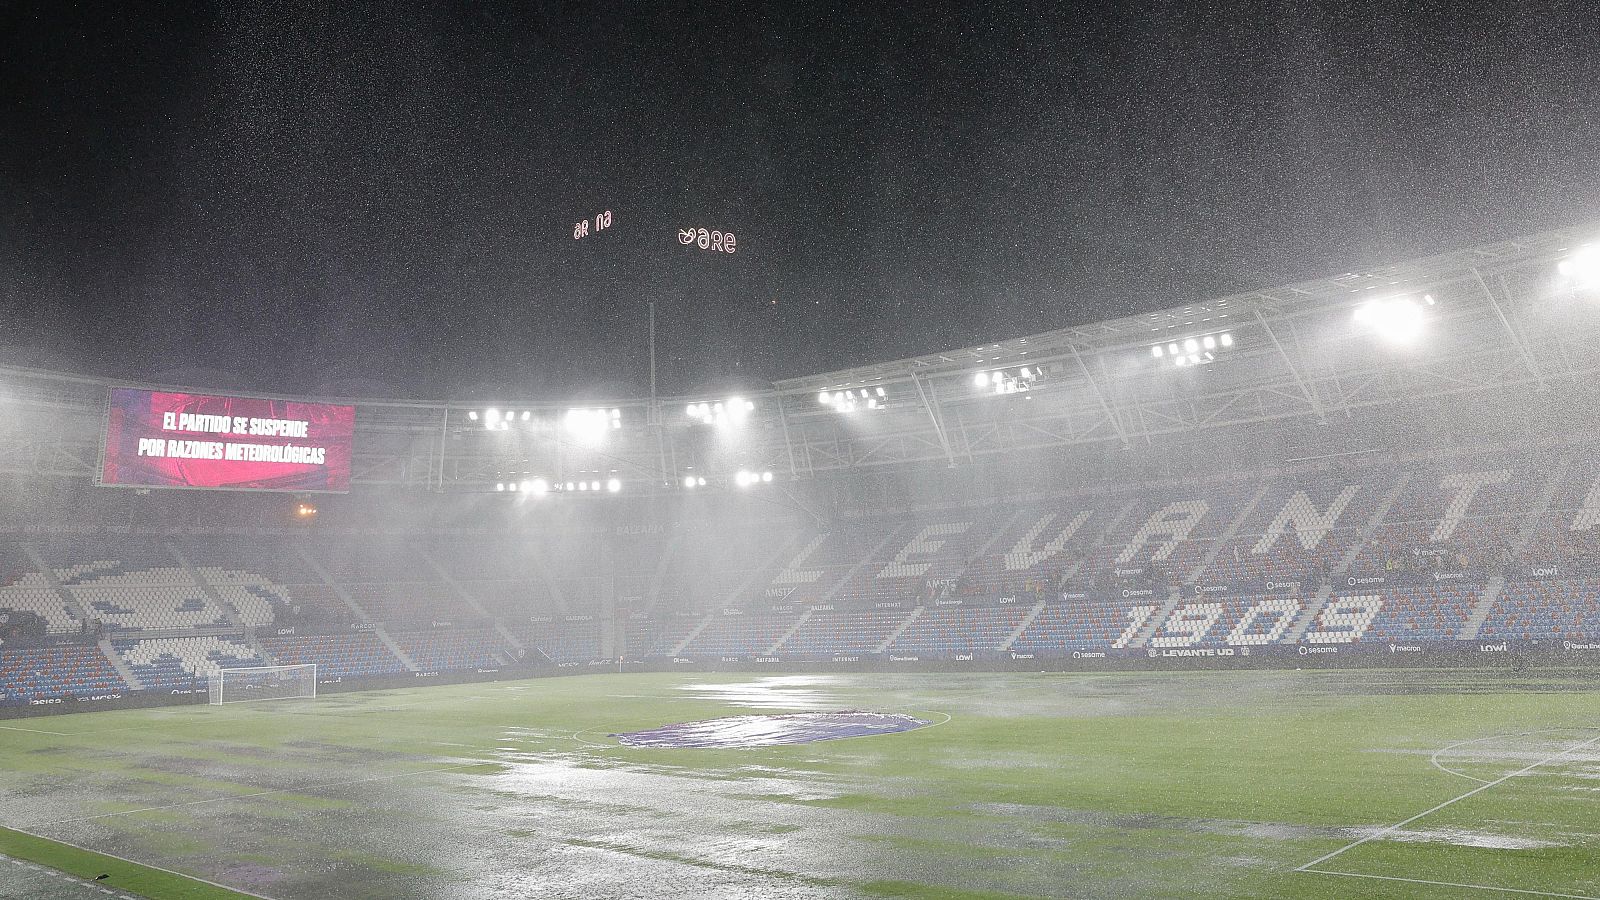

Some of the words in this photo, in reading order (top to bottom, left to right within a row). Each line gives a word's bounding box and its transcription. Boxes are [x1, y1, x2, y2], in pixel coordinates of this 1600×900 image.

[163, 411, 177, 430] EL
[179, 413, 231, 434] PARTIDO
[233, 416, 249, 436] SE
[249, 417, 309, 438] SUSPENDE
[138, 437, 165, 457] POR
[167, 438, 223, 460] RAZONES
[225, 442, 326, 465] METEOROLÓGICAS
[1129, 588, 1152, 596] sesame
[1111, 595, 1383, 649] 1909
[1163, 649, 1215, 657] LEVANTE
[1217, 648, 1235, 656] UD
